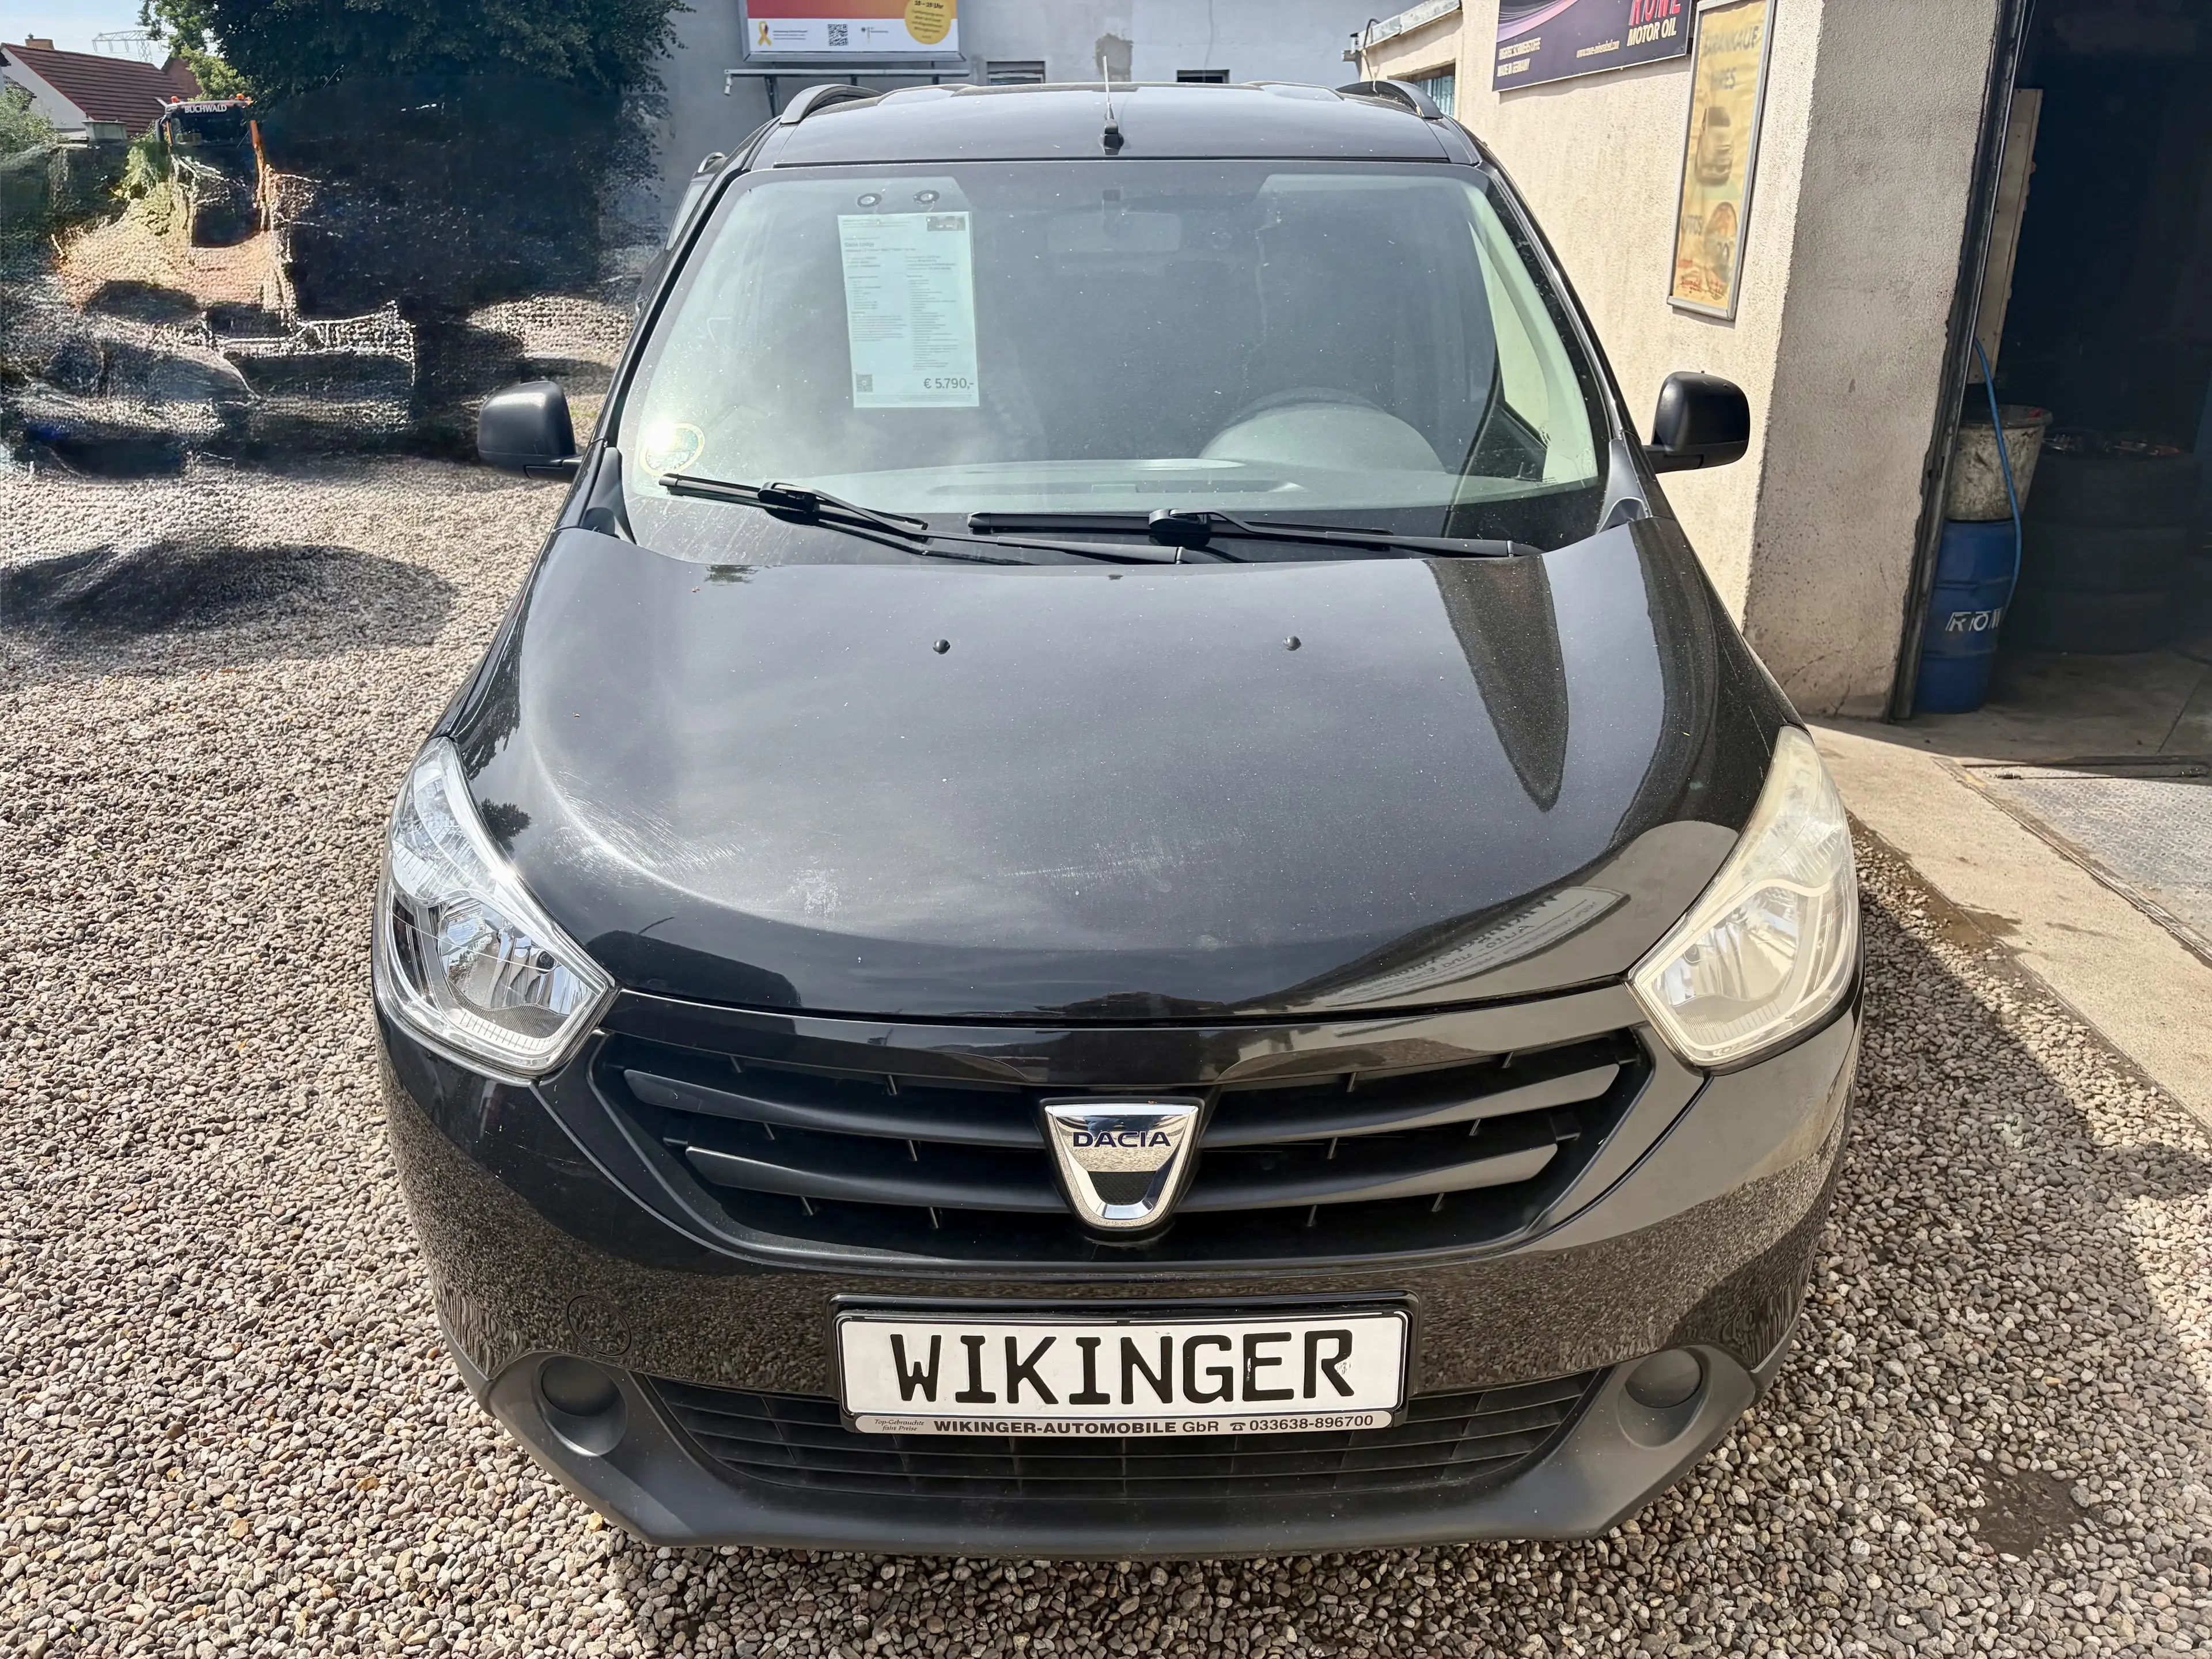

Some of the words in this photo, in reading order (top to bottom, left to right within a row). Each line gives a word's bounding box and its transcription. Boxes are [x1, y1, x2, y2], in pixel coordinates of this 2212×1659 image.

[1627, 22, 1660, 46] MOTOR
[1661, 17, 1677, 38] OIL
[185, 104, 227, 113] BUCHWALD
[924, 378, 932, 389] €
[935, 378, 974, 391] 5.790,-
[1073, 1131, 1171, 1147] DACIA
[890, 1330, 1354, 1406] WIKINGER
[934, 1421, 1176, 1434] WIKINGER-AUTOMOBILE
[1183, 1421, 1219, 1433] GbR
[1249, 1415, 1374, 1431] 033638-896700
